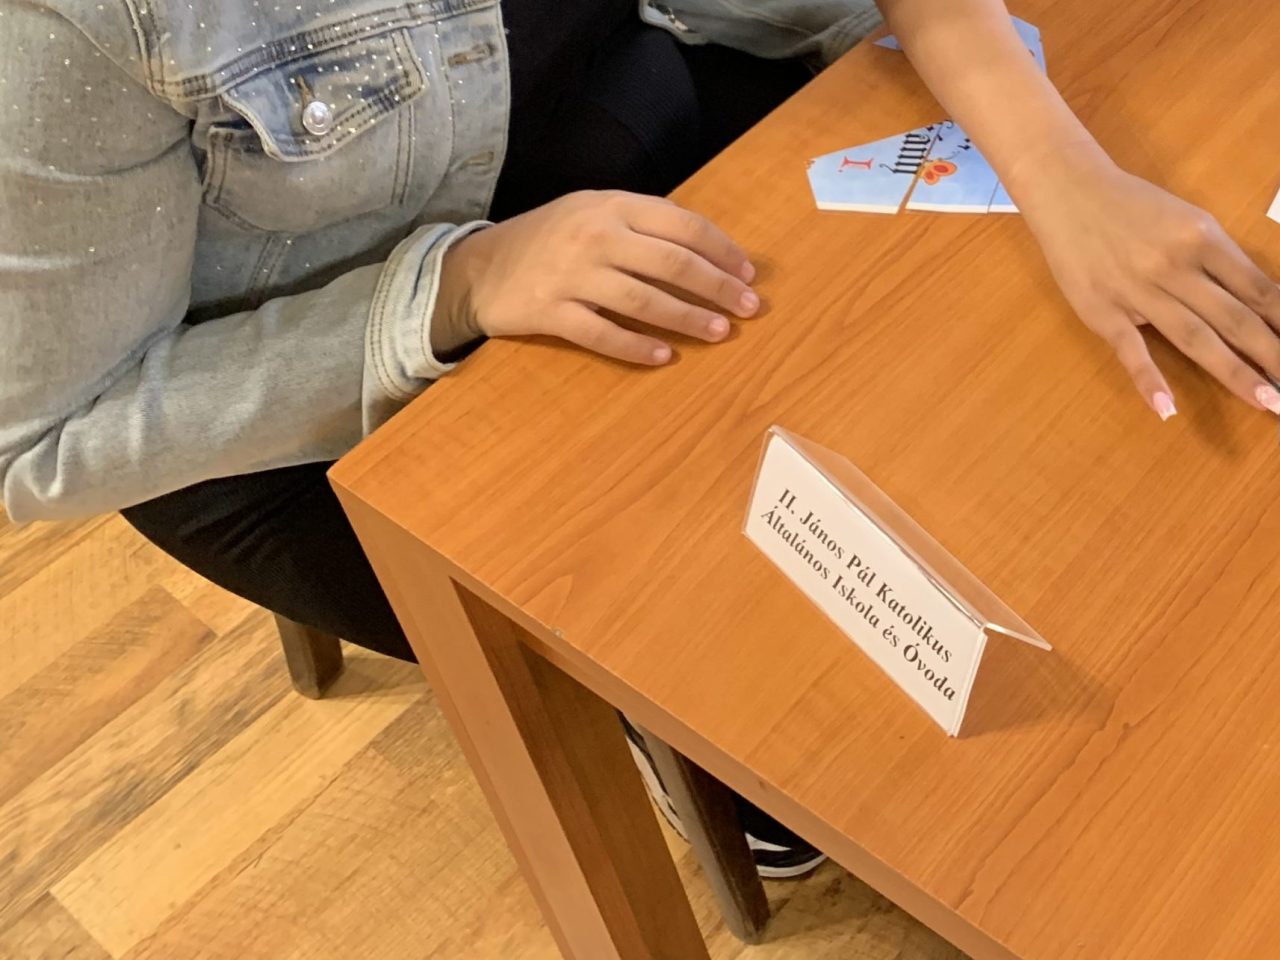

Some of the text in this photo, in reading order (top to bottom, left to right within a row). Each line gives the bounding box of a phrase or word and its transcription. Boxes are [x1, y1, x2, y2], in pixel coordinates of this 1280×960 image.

[760, 505, 956, 701] Általános Iskola és Óvoda
[778, 488, 953, 664] II. János Pál Katolikus
